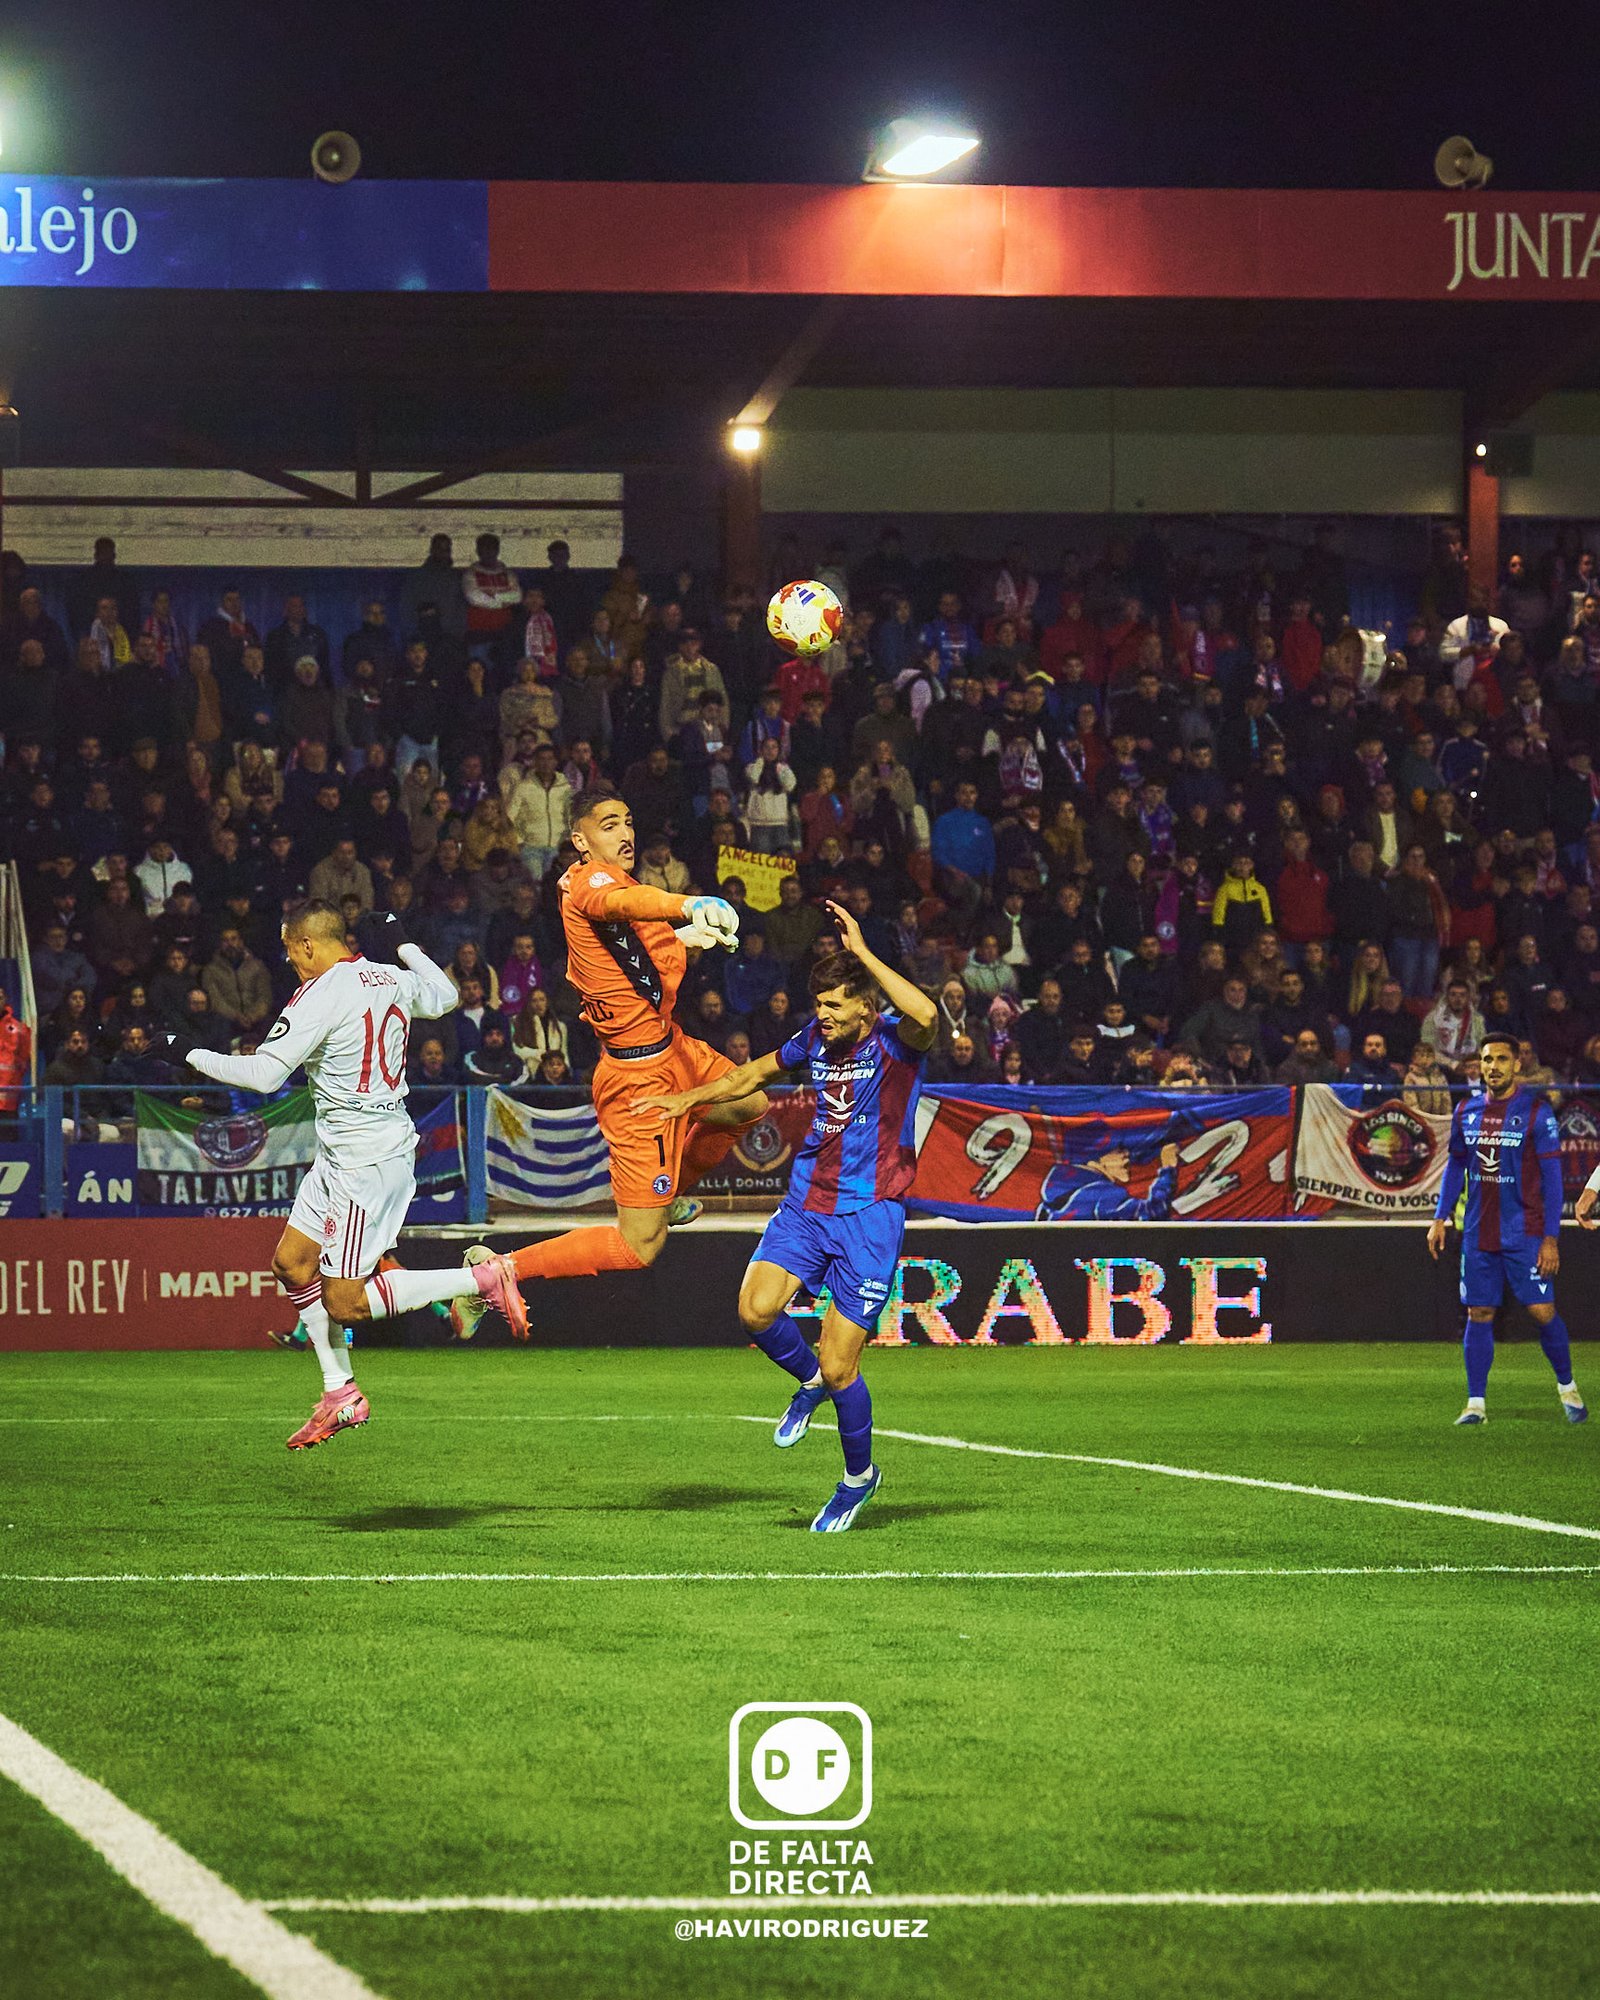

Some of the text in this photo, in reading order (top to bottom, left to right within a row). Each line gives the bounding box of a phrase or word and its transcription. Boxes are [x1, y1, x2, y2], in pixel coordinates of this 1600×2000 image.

[356, 1003, 408, 1093] 10
[826, 1068, 876, 1082] MAVEN
[653, 1134, 666, 1168] 1
[1477, 1138, 1522, 1146] MAVEN
[698, 1176, 782, 1188] ALLÁ DONDE
[1296, 1176, 1362, 1201] SIEMPRE
[1364, 1190, 1397, 1206] CON
[219, 1207, 252, 1218] 627
[68, 1259, 130, 1314] REY
[760, 1256, 1273, 1347] RABE
